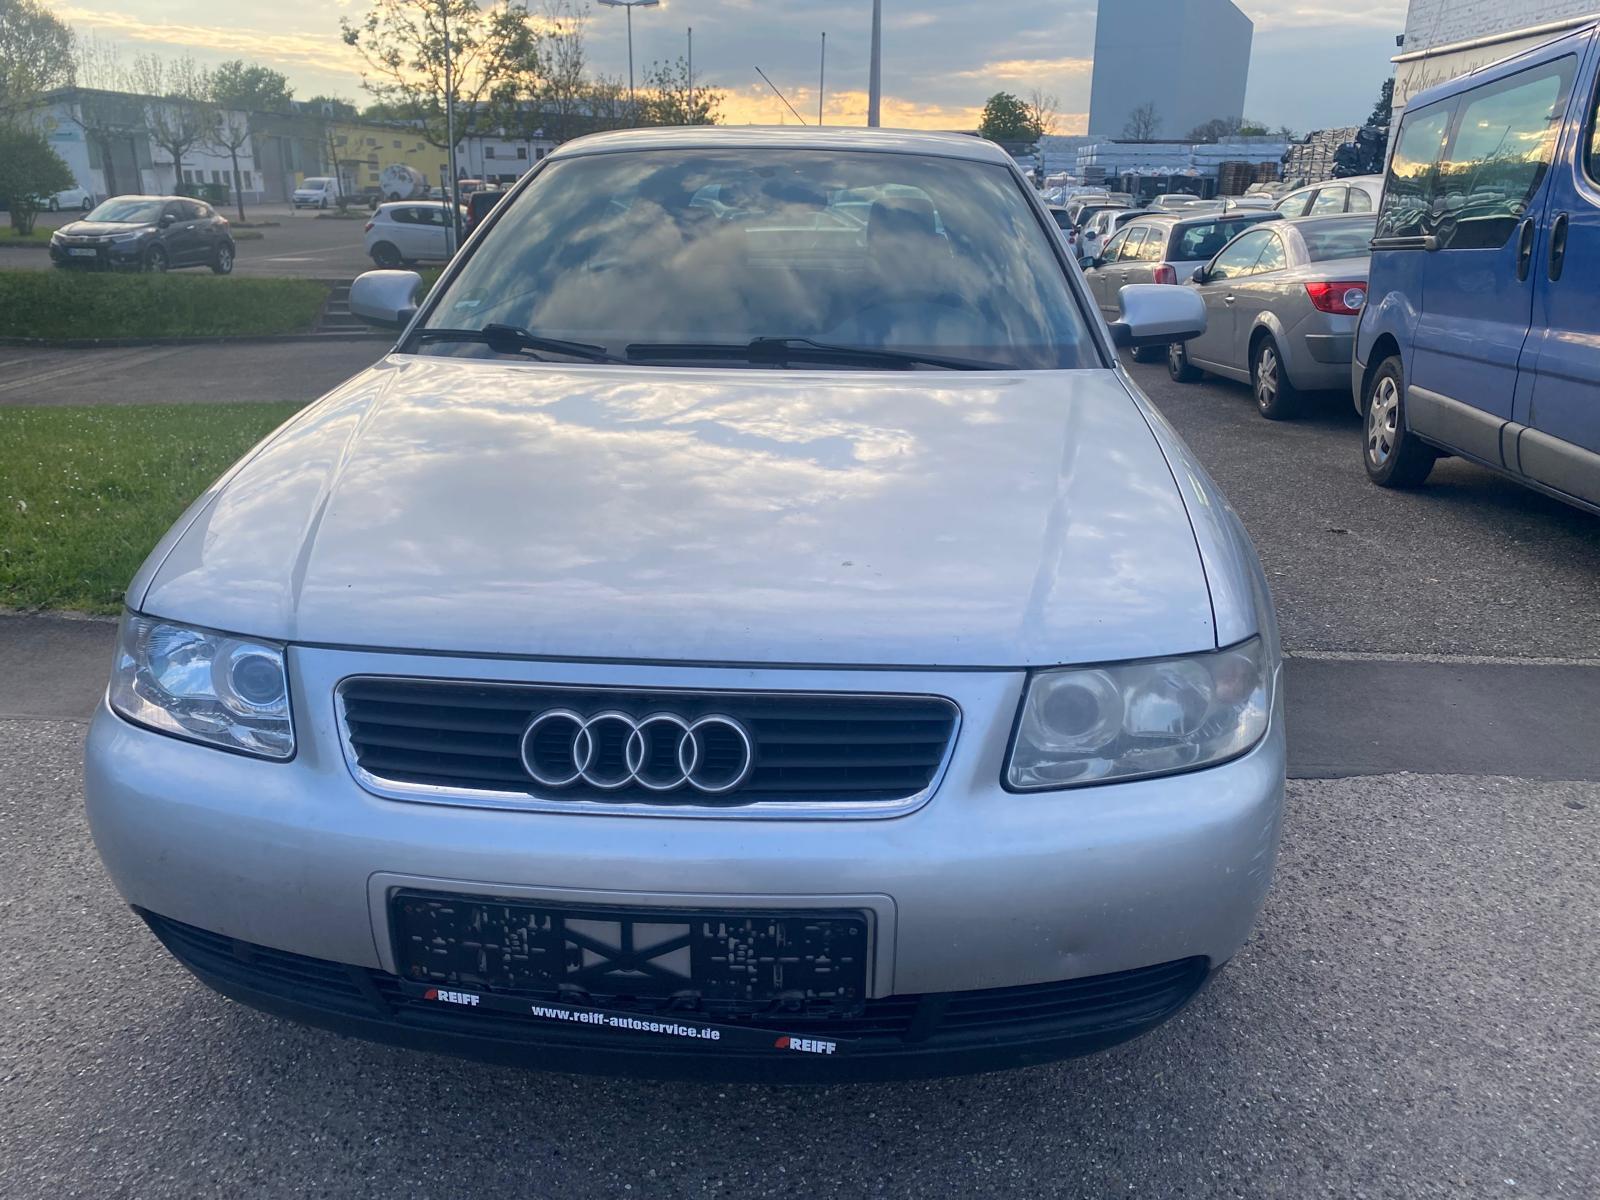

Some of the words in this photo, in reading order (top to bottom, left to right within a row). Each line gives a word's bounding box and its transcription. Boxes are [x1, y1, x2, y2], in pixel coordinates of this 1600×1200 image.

[437, 989, 480, 1006] REIFF
[531, 1005, 721, 1041] www.reiff-autoservice.de
[789, 1037, 837, 1055] REIFF
